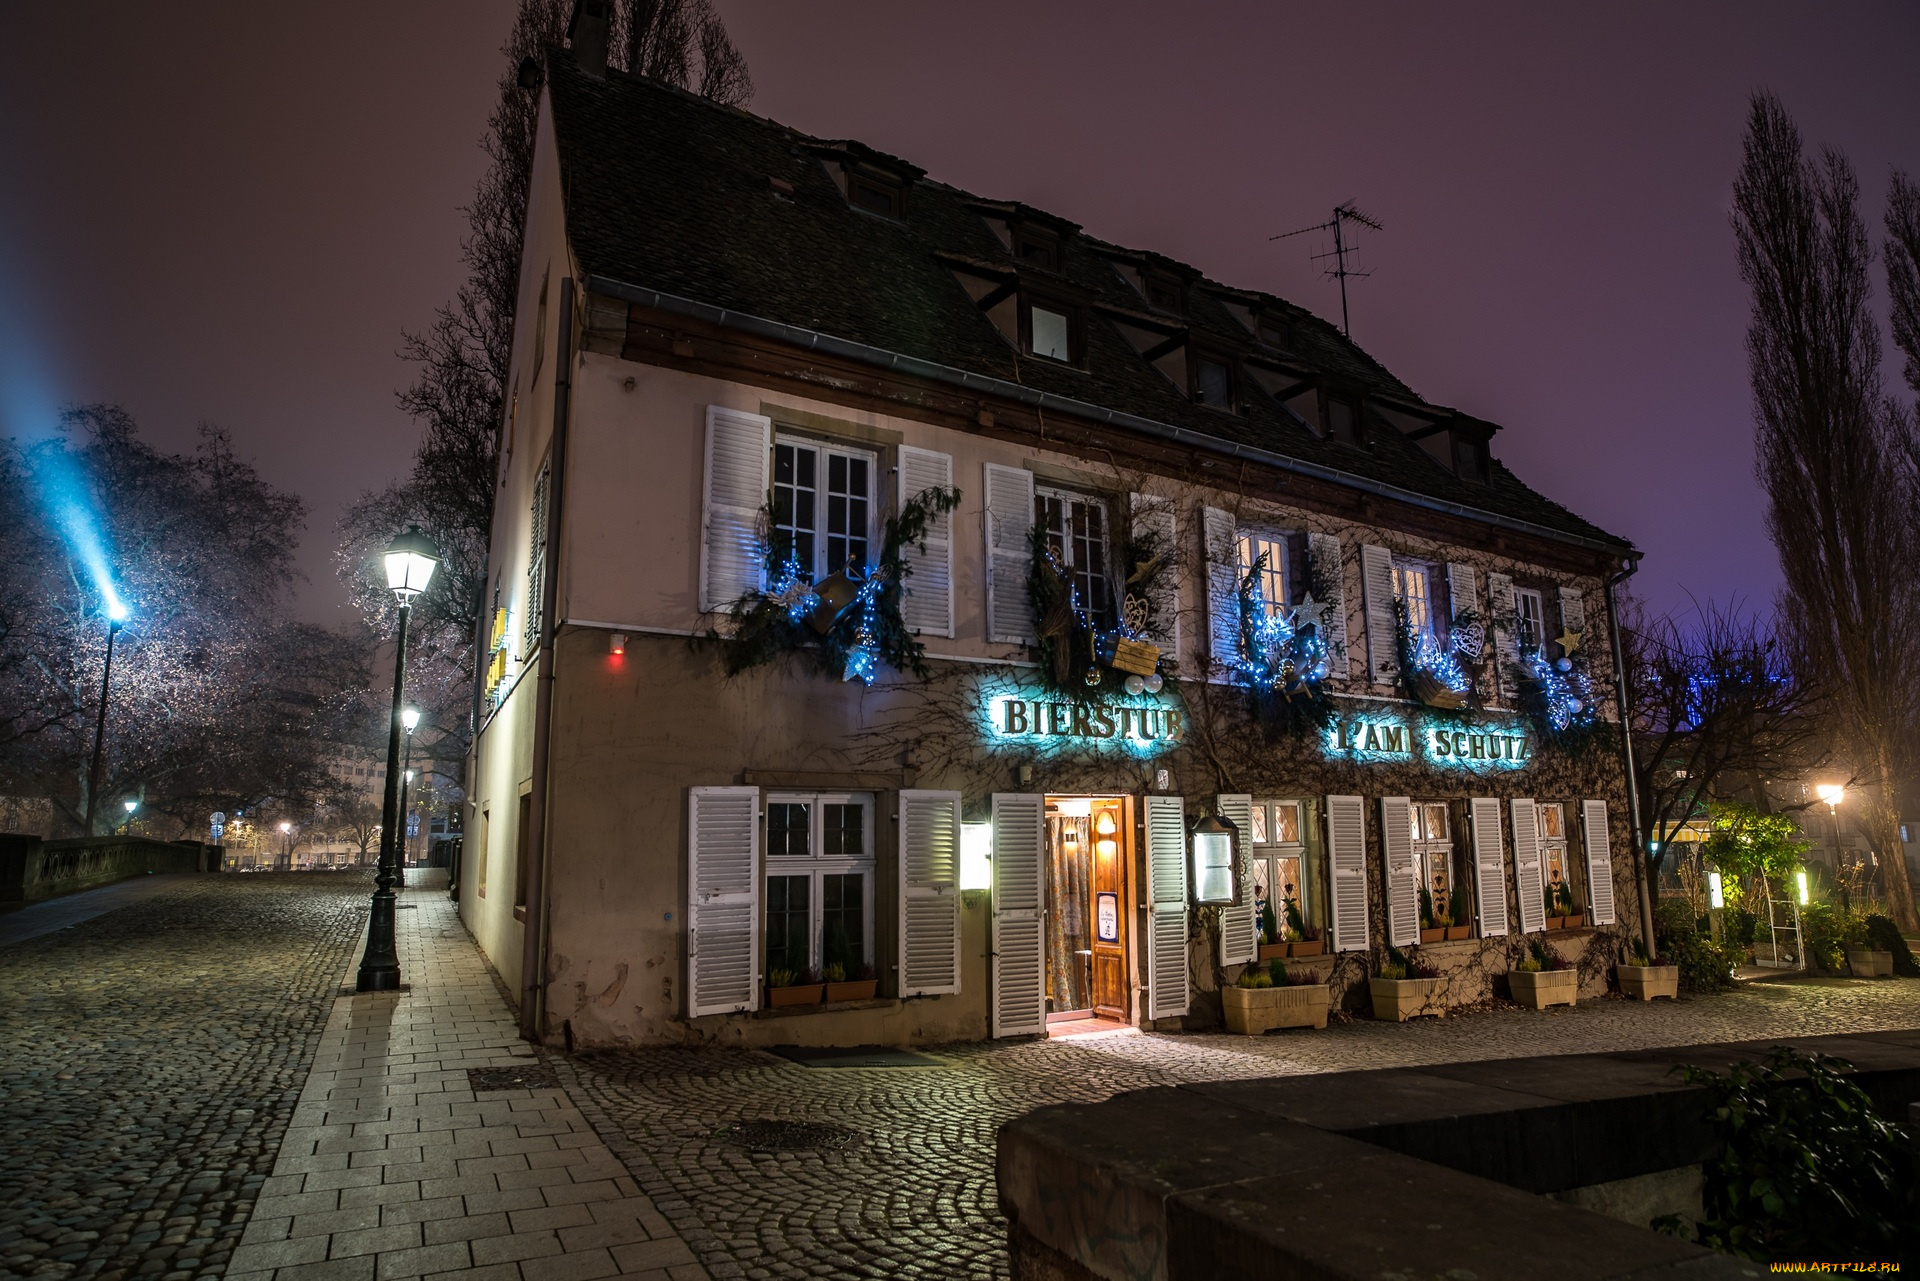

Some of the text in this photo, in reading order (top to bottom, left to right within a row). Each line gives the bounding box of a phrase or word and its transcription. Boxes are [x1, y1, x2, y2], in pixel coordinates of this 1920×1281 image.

[1002, 699, 1531, 760] BIERSTUB L'AMI SCHUTZ
